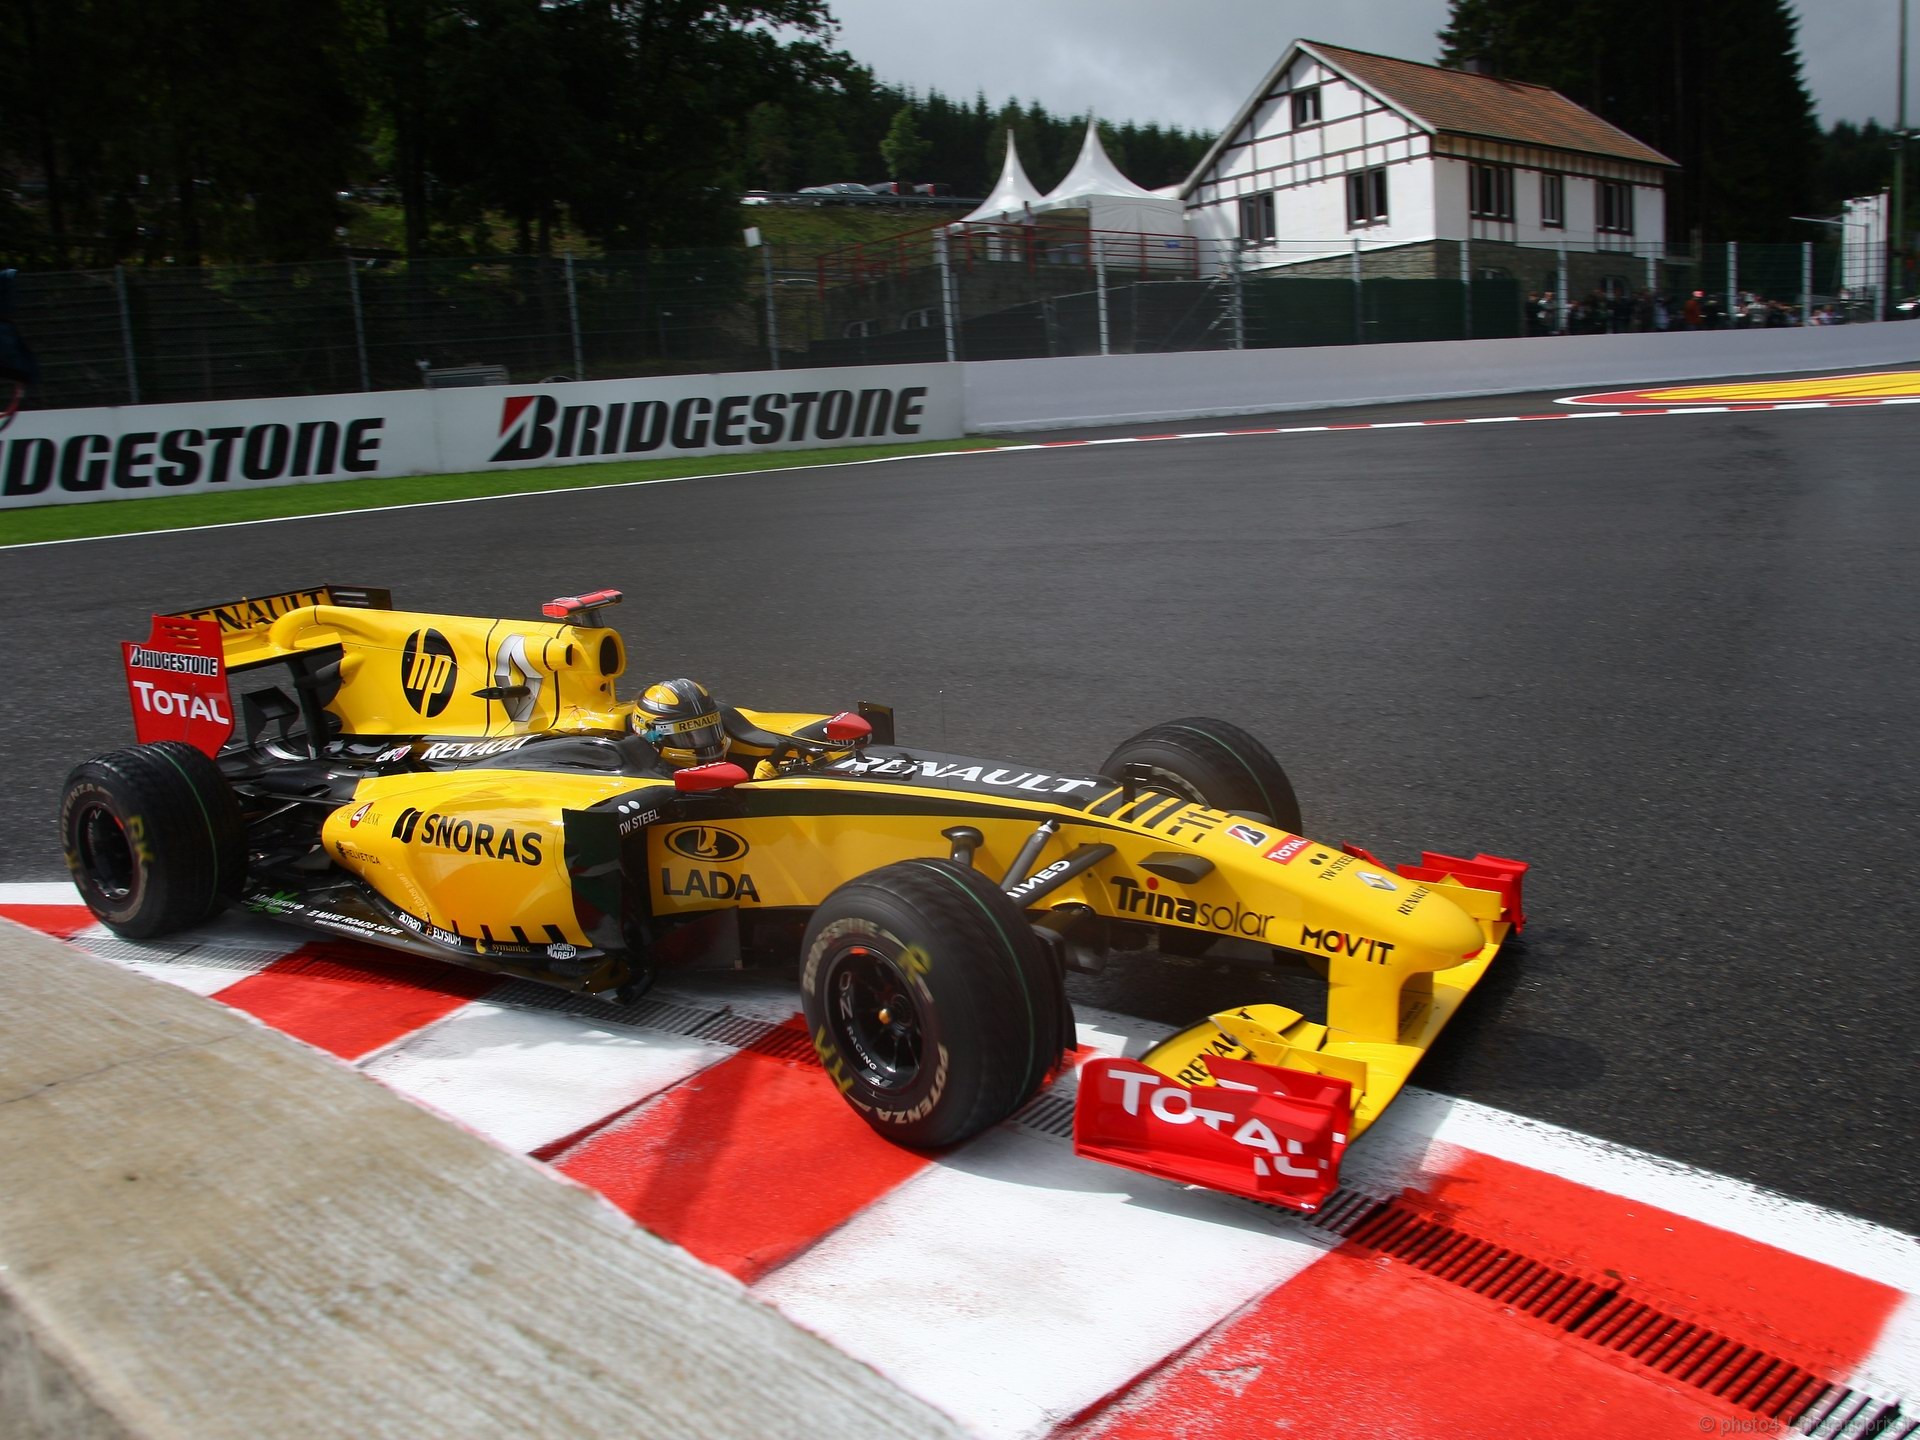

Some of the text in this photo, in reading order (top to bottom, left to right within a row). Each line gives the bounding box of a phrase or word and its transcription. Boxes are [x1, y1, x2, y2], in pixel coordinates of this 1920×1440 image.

[490, 386, 928, 462] BRIDGESTONE
[0, 417, 386, 497] DGESTONE
[131, 645, 218, 677] BRIDGESTONE
[405, 629, 453, 717] hp
[133, 680, 230, 725] TOTAL
[679, 712, 720, 732] RENAULT
[375, 747, 397, 763] elf
[420, 734, 542, 760] RENAULT
[834, 757, 1097, 793] RENAULT
[619, 808, 661, 836] TW STEEL
[421, 813, 543, 867] SNORAS
[1268, 837, 1308, 862] TOTAL
[346, 849, 381, 865] HELVETICA
[1318, 854, 1356, 881] TW STEEL
[661, 867, 761, 903] LADA
[1397, 885, 1432, 915] RENAULT
[317, 911, 404, 936] MAKE ROADS SAFE
[432, 927, 462, 947] ELYSIUM
[492, 943, 531, 954] symantec
[846, 1025, 878, 1071] RACING
[1108, 1068, 1319, 1180] TOTAL
